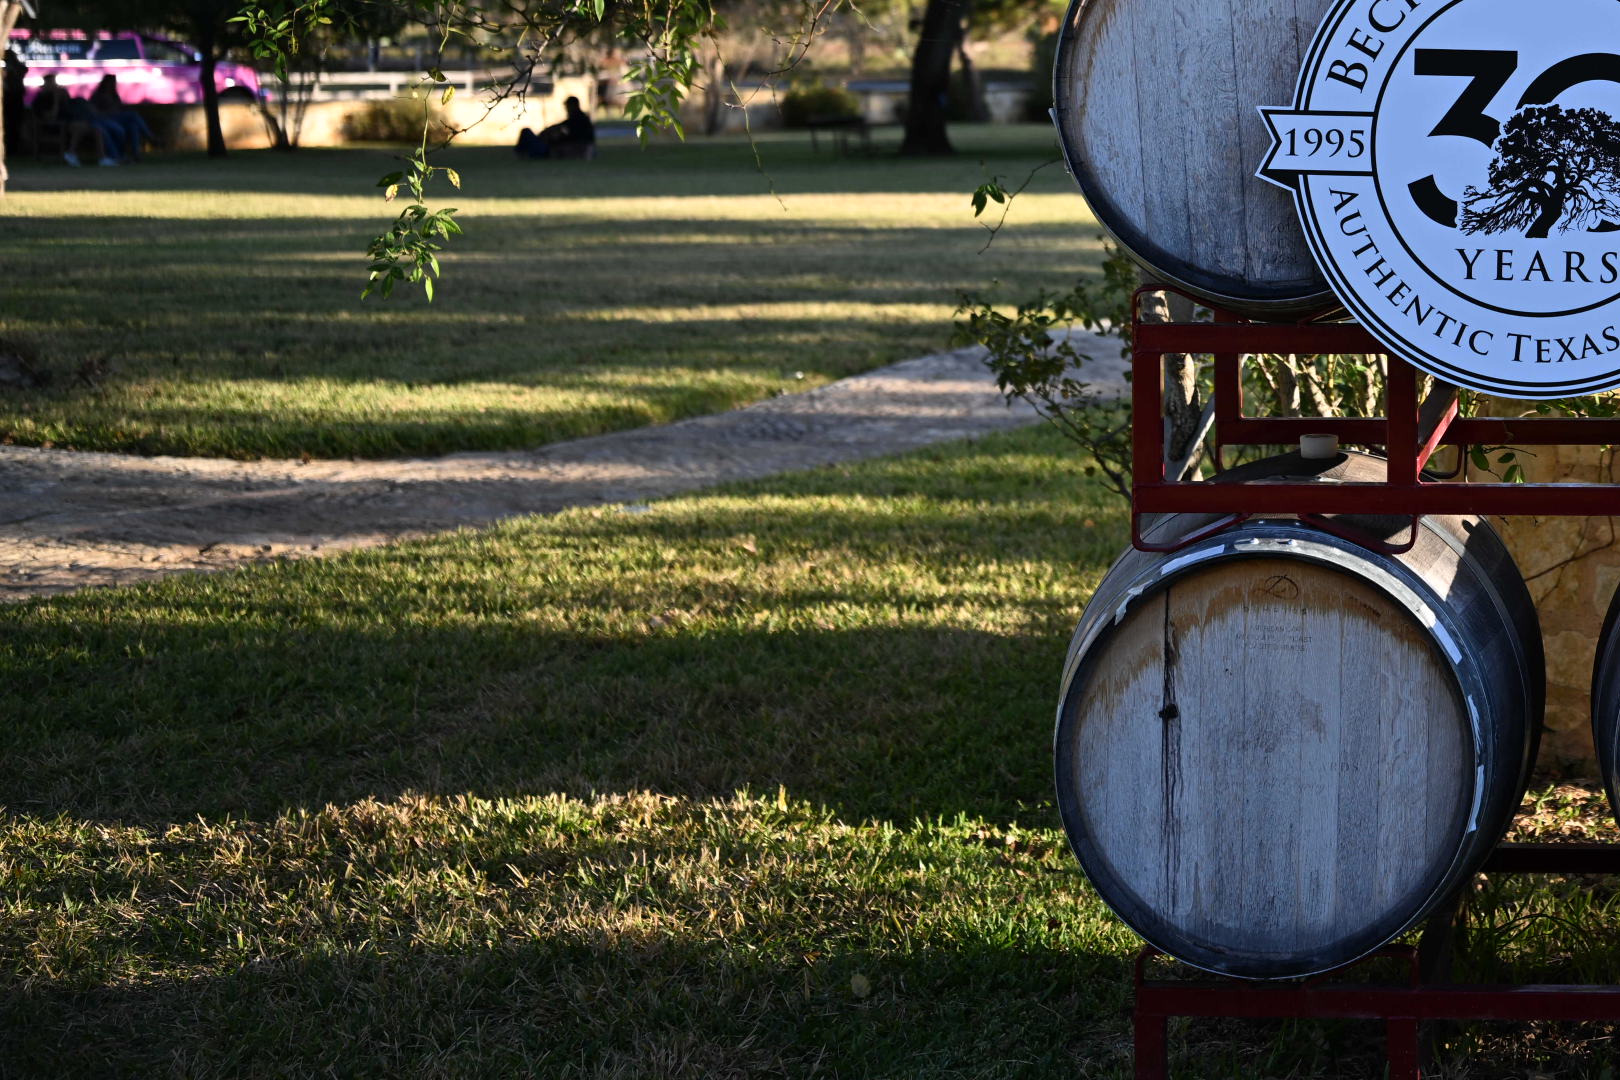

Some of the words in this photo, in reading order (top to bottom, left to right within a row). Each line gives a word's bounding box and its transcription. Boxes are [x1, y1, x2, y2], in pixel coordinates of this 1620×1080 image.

[1284, 128, 1366, 159] 1995
[1328, 186, 1495, 357] AUTHENTIC
[1506, 324, 1620, 365] TEXAS
[1455, 247, 1620, 284] YEARS
